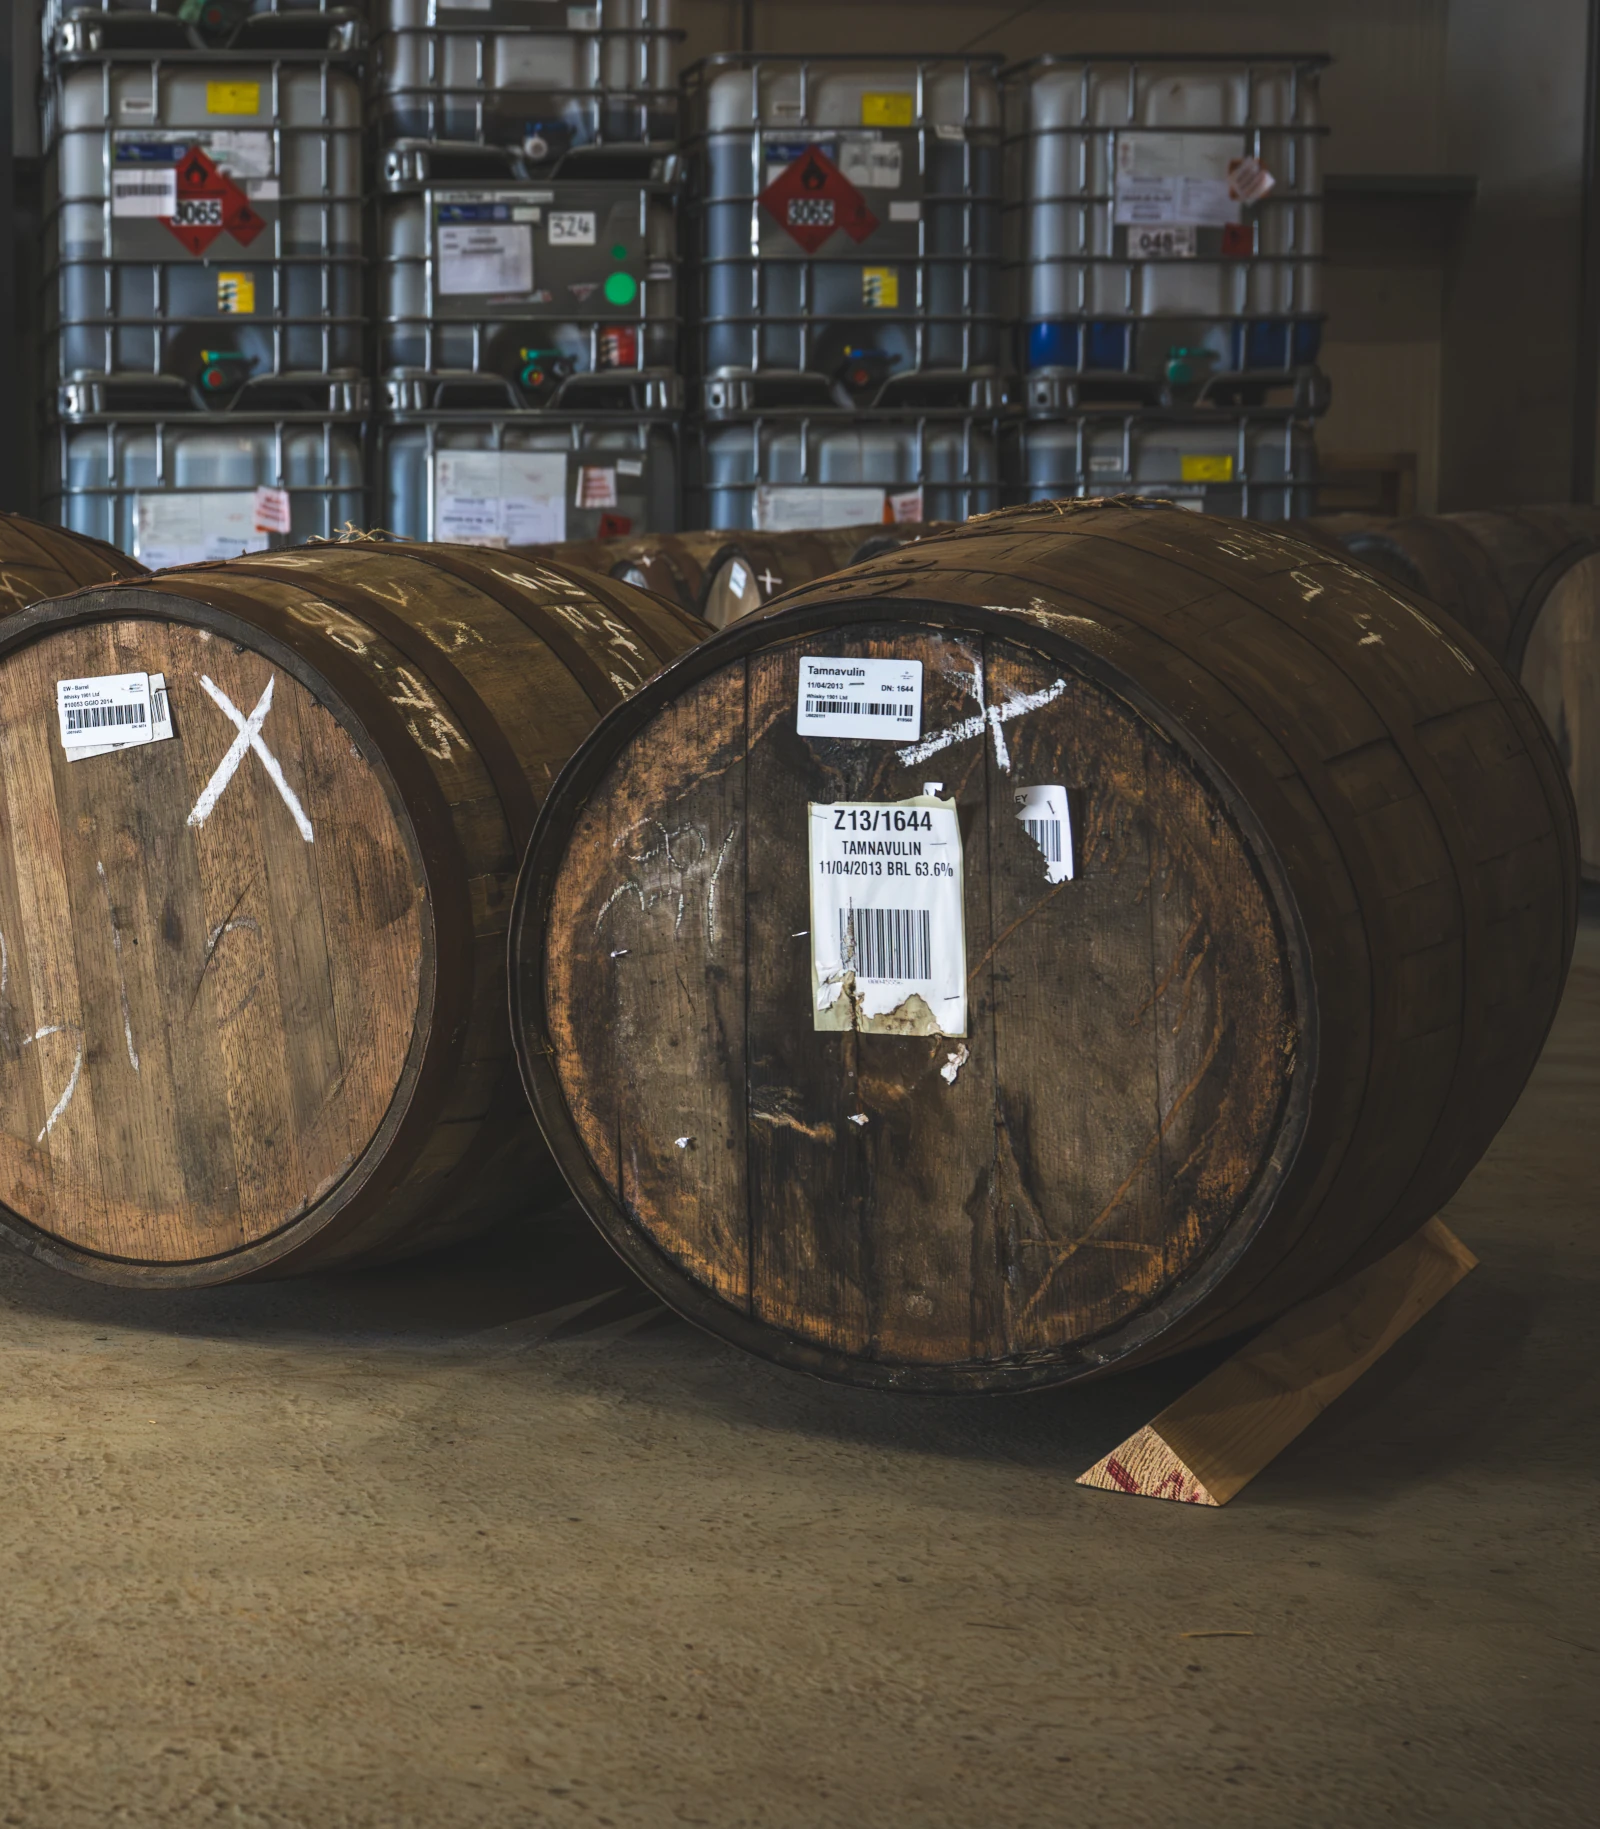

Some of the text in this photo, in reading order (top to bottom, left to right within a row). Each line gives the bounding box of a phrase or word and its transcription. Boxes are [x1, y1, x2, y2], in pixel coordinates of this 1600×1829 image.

[807, 665, 866, 677] Tamnavulin
[807, 682, 844, 690] 11/04/2013
[834, 809, 932, 831] Z13/1644
[842, 840, 922, 856] TAMNAVULIN
[819, 861, 954, 877] 11/04/2013 BRL 63.6%
